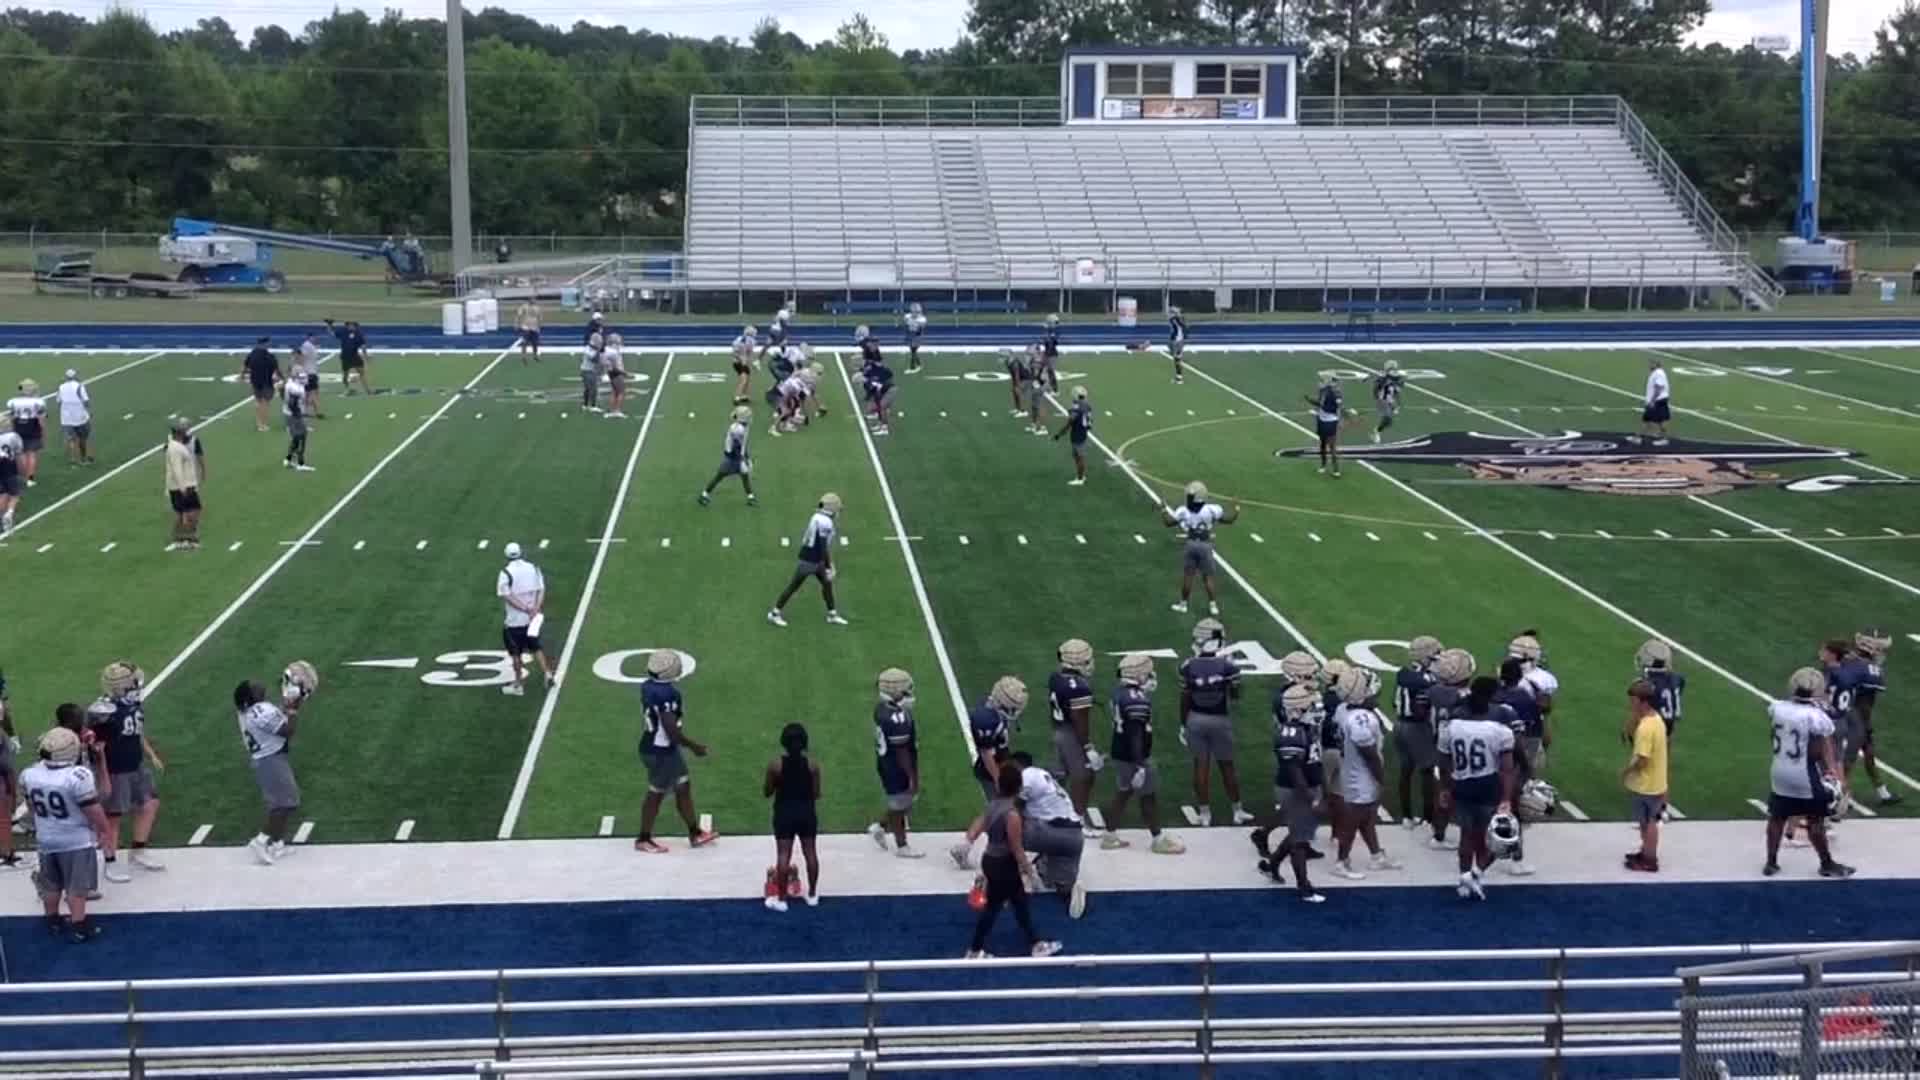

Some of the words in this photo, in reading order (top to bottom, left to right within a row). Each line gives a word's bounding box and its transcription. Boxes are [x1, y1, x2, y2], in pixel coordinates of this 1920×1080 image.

[1660, 687, 1682, 720] 31
[1453, 737, 1487, 773] 86
[1770, 723, 1802, 760] 53
[29, 788, 70, 820] 69
